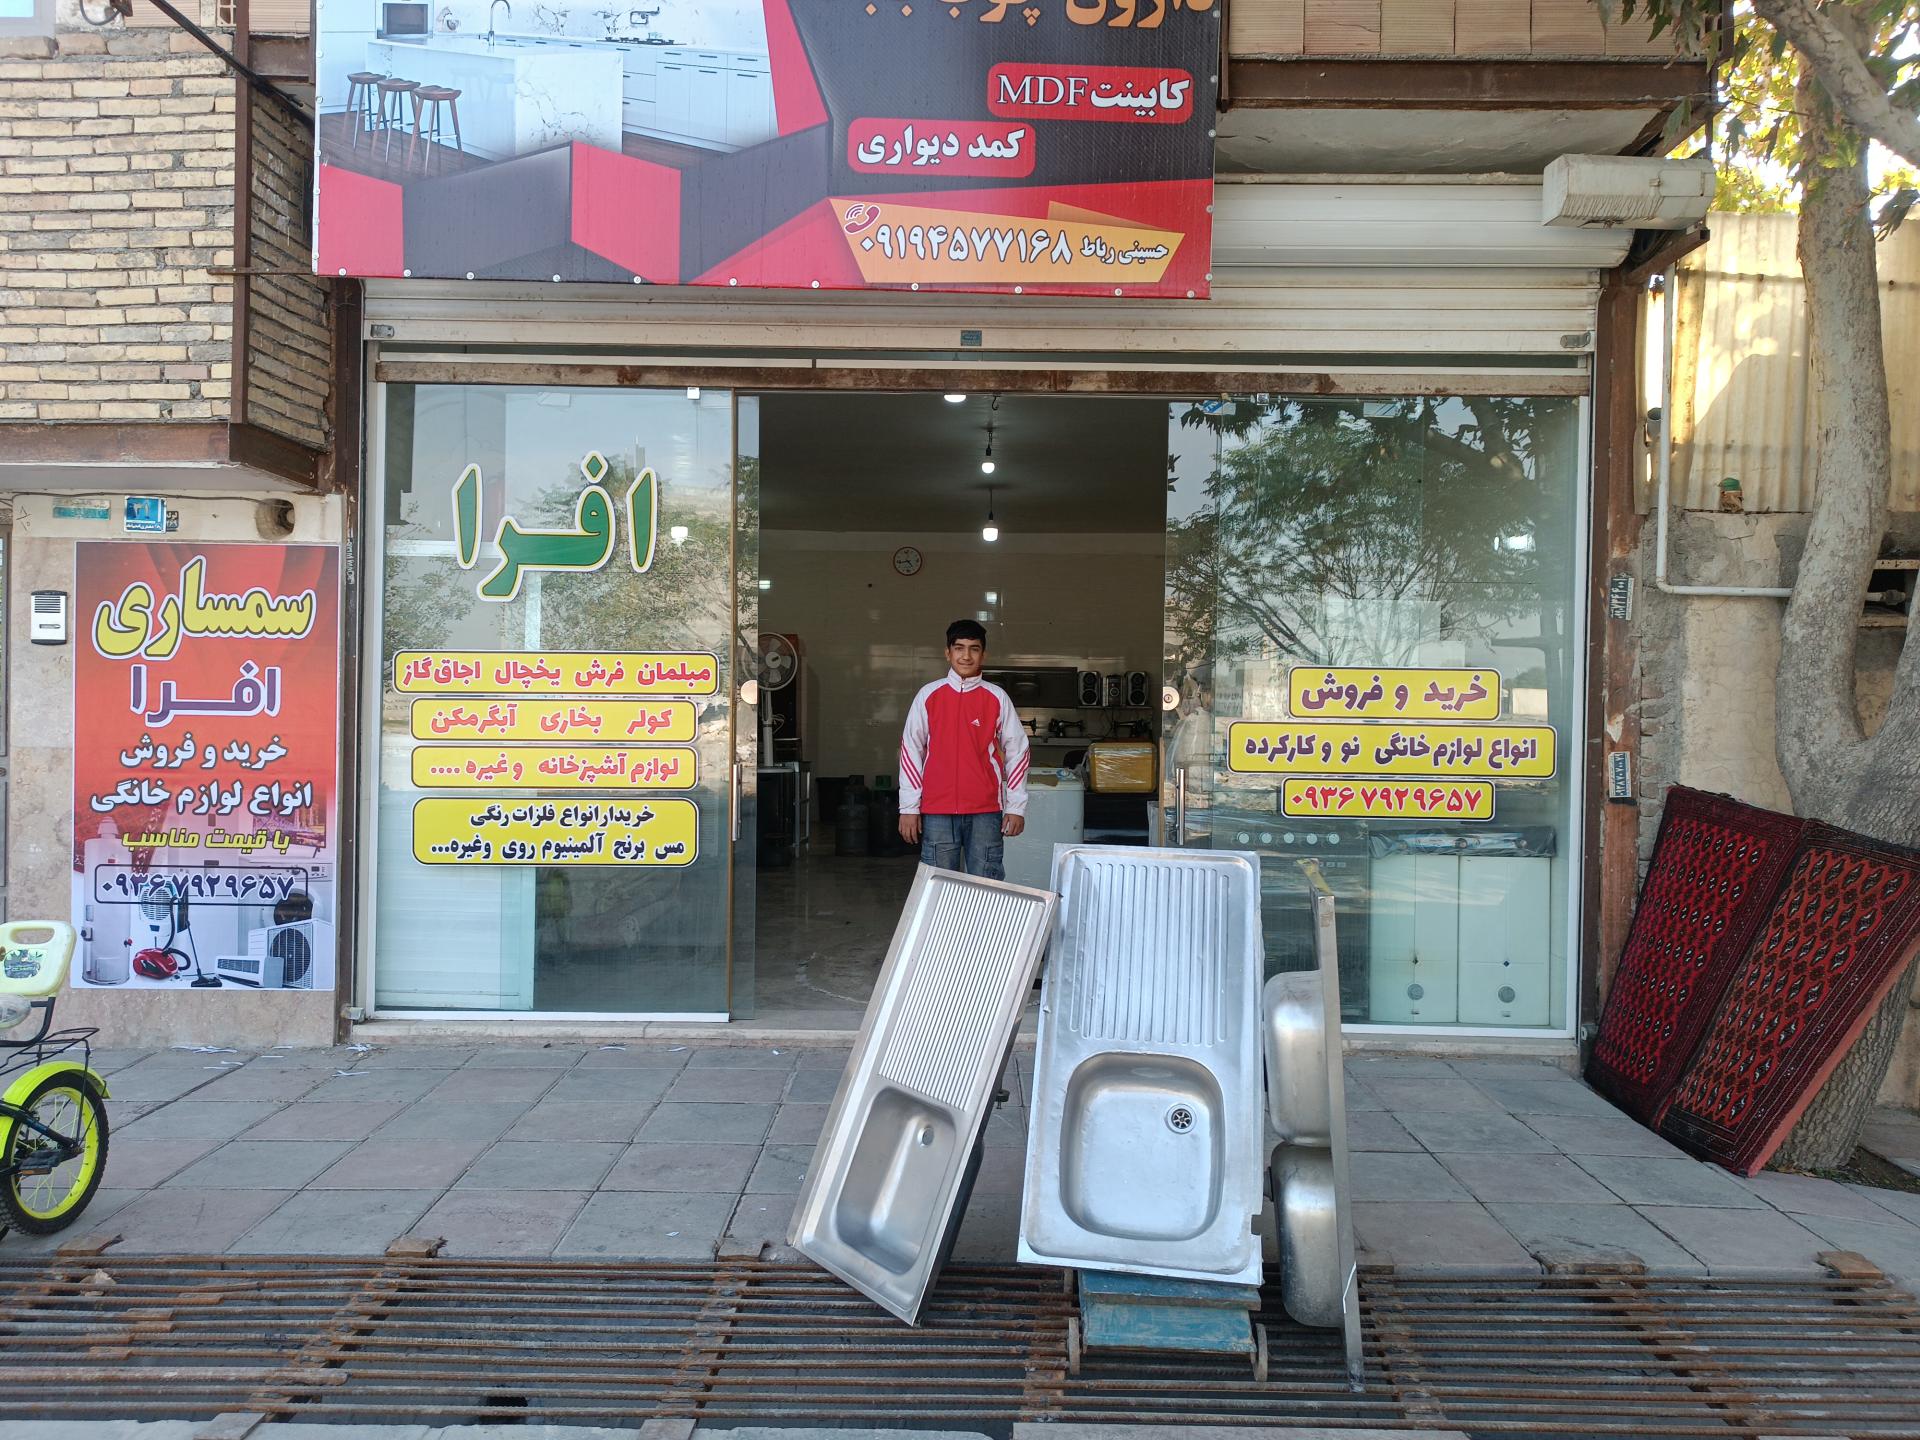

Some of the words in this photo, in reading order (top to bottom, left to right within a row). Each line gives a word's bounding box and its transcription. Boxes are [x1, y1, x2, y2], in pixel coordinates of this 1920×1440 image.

[997, 74, 1089, 106] MDF
[1090, 78, 1191, 117] کابینت
[857, 124, 960, 166] دیواری
[967, 128, 1025, 159] کمد
[860, 224, 1073, 264] ۰۹۱۹۴۵۷۷۱۶۸
[1080, 235, 1116, 265] رباط
[1117, 241, 1169, 265] حسینی
[452, 450, 659, 602] افرا
[93, 555, 317, 661] سمساری
[402, 656, 433, 686] گاز
[433, 657, 482, 686] اجاق
[494, 658, 561, 689] یخچال
[574, 659, 625, 687] فرش
[637, 662, 711, 687] مبلمان
[130, 659, 282, 728] افرا
[1301, 672, 1384, 711] فروش
[1394, 683, 1409, 711] و
[1423, 674, 1488, 712] خرید
[430, 703, 518, 734] آبگرمکن
[540, 706, 602, 735] بخاری
[626, 709, 673, 735] کولر
[120, 731, 196, 769] فروش
[201, 744, 217, 769] و
[222, 735, 288, 769] خرید
[1245, 734, 1316, 763] کارکرده
[1321, 740, 1332, 764] و
[1340, 735, 1360, 764] نو
[1374, 732, 1431, 765] خانگی
[1433, 738, 1483, 766] لوازم
[1487, 738, 1537, 769] انواع
[512, 761, 523, 782] و
[538, 752, 628, 783] آشپزخانه
[630, 757, 679, 784] لوازم
[90, 777, 171, 813] خانگی
[176, 779, 244, 816] لوازم
[249, 780, 313, 816] انواع
[470, 804, 510, 828] رنگی
[511, 804, 556, 827] فلزات
[559, 805, 600, 827] انواع
[600, 806, 655, 828] خریدار
[121, 827, 201, 853] مناسب
[204, 828, 267, 855] قیمت
[271, 829, 290, 855] با
[501, 840, 535, 861] روی
[541, 832, 605, 861] آلمینیوم
[612, 835, 646, 861] برنج
[654, 839, 685, 860] مس
